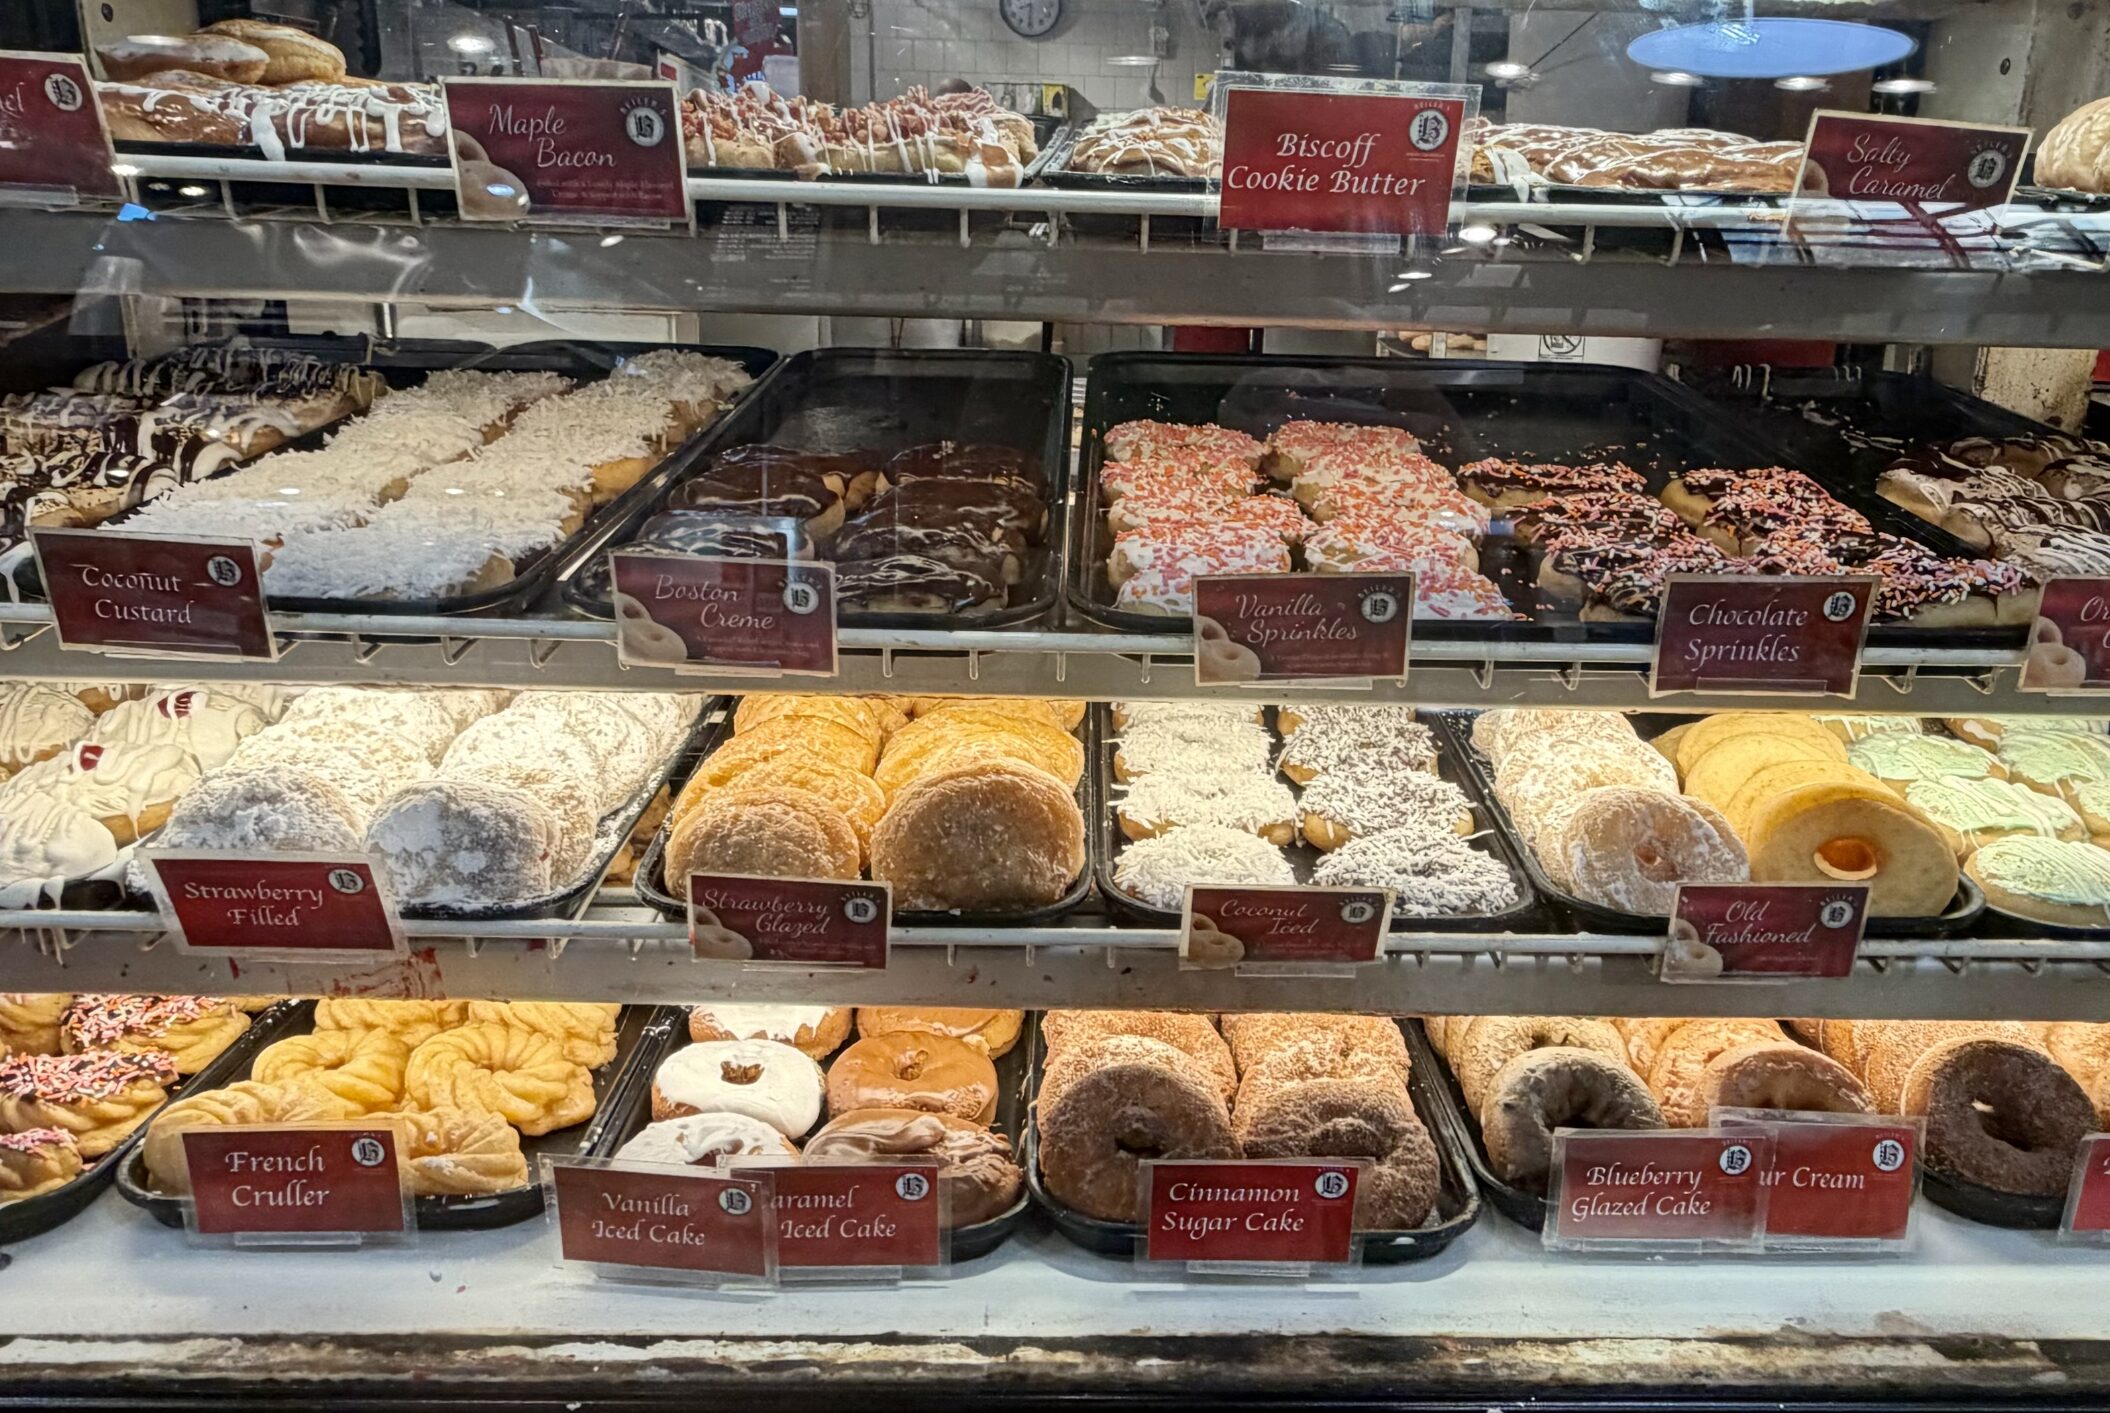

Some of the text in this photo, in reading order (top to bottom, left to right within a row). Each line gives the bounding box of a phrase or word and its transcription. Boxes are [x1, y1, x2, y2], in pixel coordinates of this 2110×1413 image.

[489, 103, 567, 142] Maple
[536, 137, 617, 168] Bacon
[1276, 133, 1381, 168] Biscoff
[1228, 164, 1426, 196] Cookie Butter
[1850, 165, 1956, 200] Caramel
[82, 566, 182, 593] Coconut
[655, 574, 741, 602] Boston
[95, 599, 195, 624] Custard
[700, 603, 776, 629] Creme
[1236, 593, 1322, 619] Vanilla
[1689, 599, 1808, 627] Chocolate
[1247, 618, 1358, 648] Sprinkles
[1685, 634, 1800, 672] Sprinkles
[184, 880, 324, 910] Strawberry
[702, 888, 829, 920] Strawberry
[1220, 899, 1308, 918] Coconut
[227, 905, 302, 927] Filled
[756, 912, 831, 938] Glazed
[1726, 900, 1770, 923] Old
[1267, 917, 1320, 935] Iced
[1706, 923, 1817, 945] Fashioned
[225, 1145, 326, 1173] French
[1586, 1161, 1702, 1194] Blueberry
[1792, 1166, 1866, 1190] Cream
[232, 1179, 330, 1207] Cruller
[602, 1193, 689, 1217] Vanilla
[769, 1185, 860, 1210] aramel
[1169, 1182, 1300, 1202] Cinnamon
[1571, 1191, 1711, 1223] Glazed Cake
[592, 1218, 705, 1246] Iced Cake
[781, 1214, 896, 1239] Iced Cake
[1161, 1208, 1304, 1240] Sugar Cake
